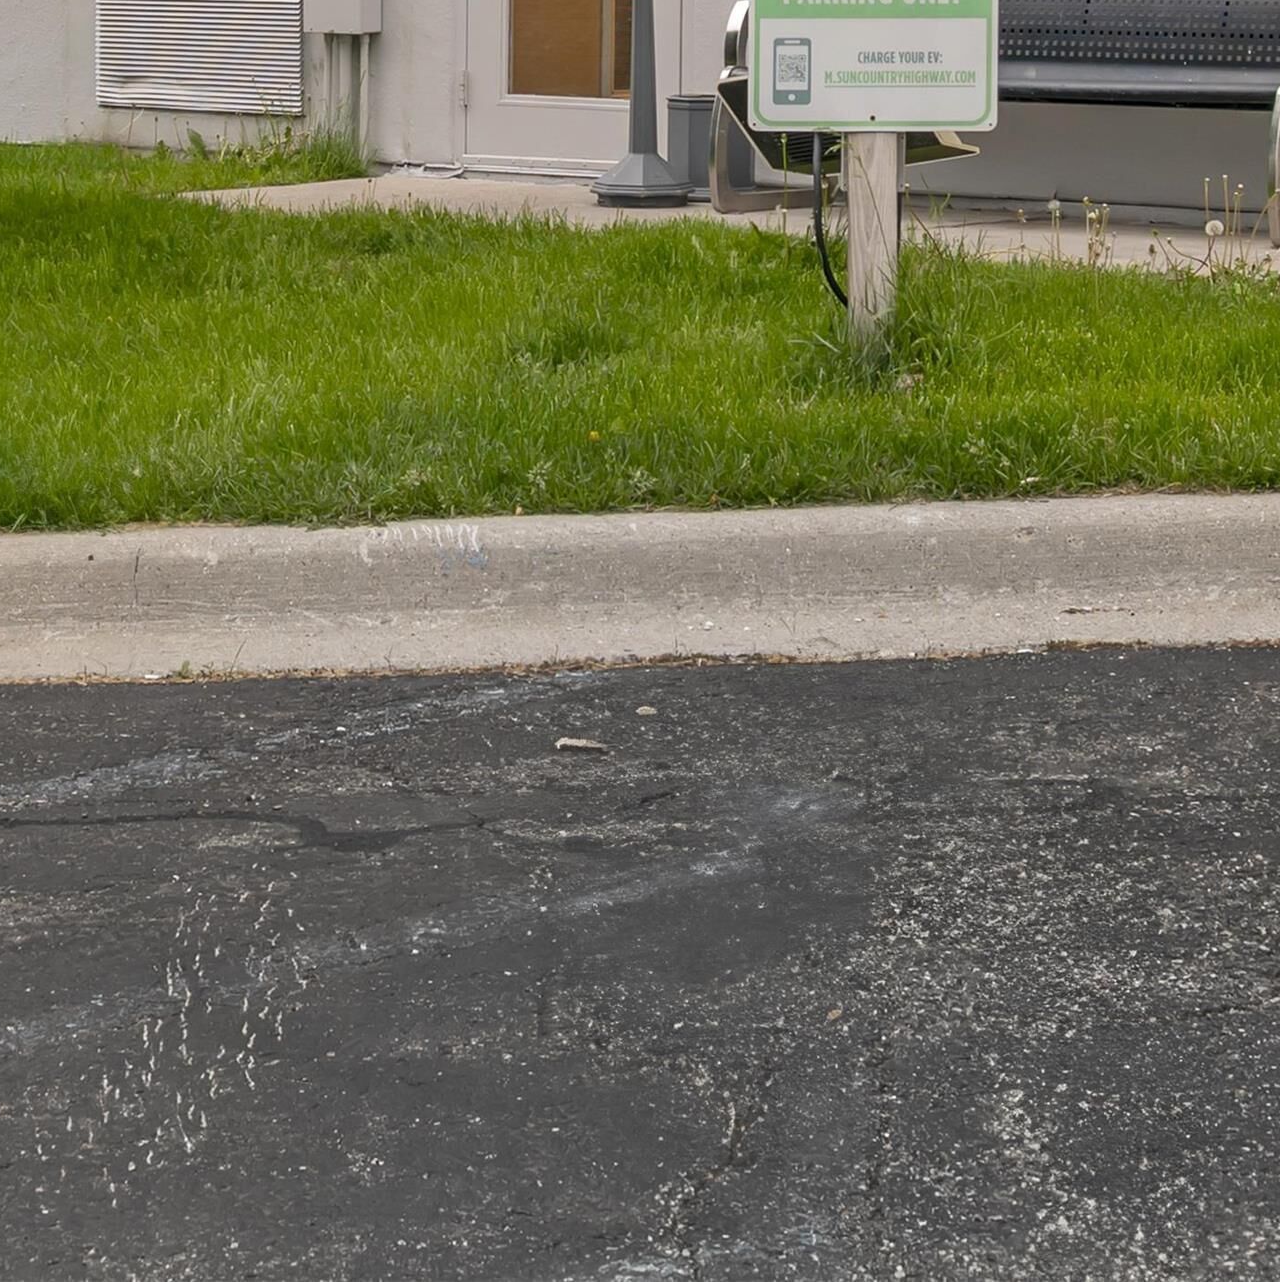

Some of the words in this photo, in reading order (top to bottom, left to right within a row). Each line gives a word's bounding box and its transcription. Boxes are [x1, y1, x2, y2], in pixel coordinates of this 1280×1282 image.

[857, 51, 895, 64] CHARGE
[898, 51, 924, 64] YOUR
[927, 51, 943, 64] EV:
[824, 71, 976, 84] M.SUNCOUNTRYHIGHWAY.COM
